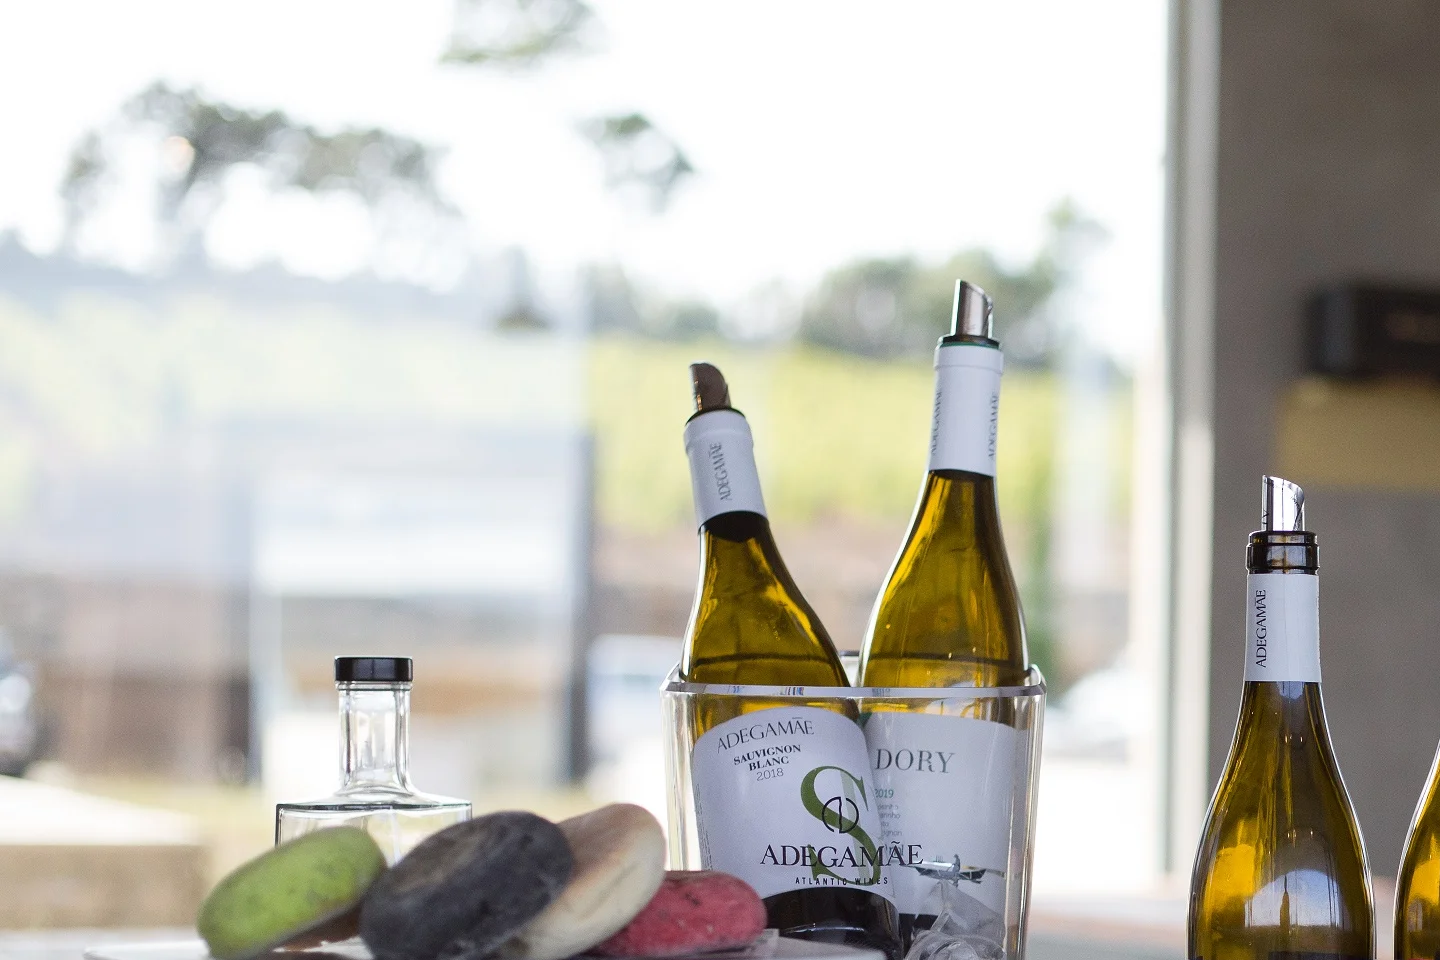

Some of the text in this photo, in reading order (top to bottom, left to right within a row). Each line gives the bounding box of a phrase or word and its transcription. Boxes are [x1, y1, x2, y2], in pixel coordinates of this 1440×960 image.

[733, 744, 802, 766] SAUVIGNON
[748, 756, 790, 772] BLANC
[876, 748, 955, 774] DORY
[756, 767, 785, 782] 2018
[760, 840, 924, 868] ADEGAMÃE
[795, 876, 888, 886] ATLANTIC WINES
